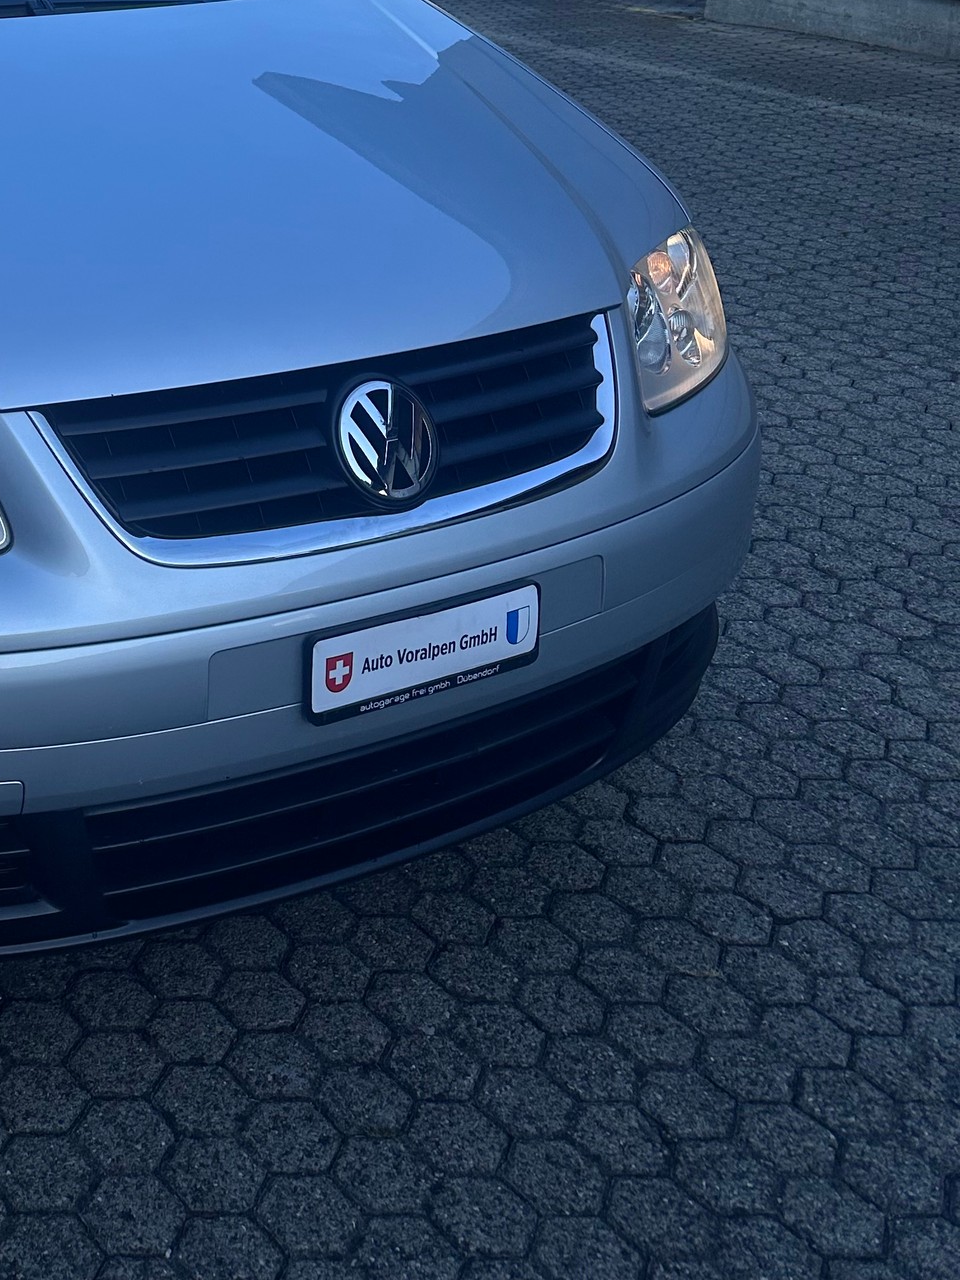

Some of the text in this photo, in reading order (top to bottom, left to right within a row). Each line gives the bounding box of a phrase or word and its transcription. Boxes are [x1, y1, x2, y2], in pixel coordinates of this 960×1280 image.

[361, 626, 498, 675] Auto Voralpen GmbH
[360, 692, 410, 712] autogarage
[411, 688, 427, 697] frei
[427, 680, 451, 695] gmbh
